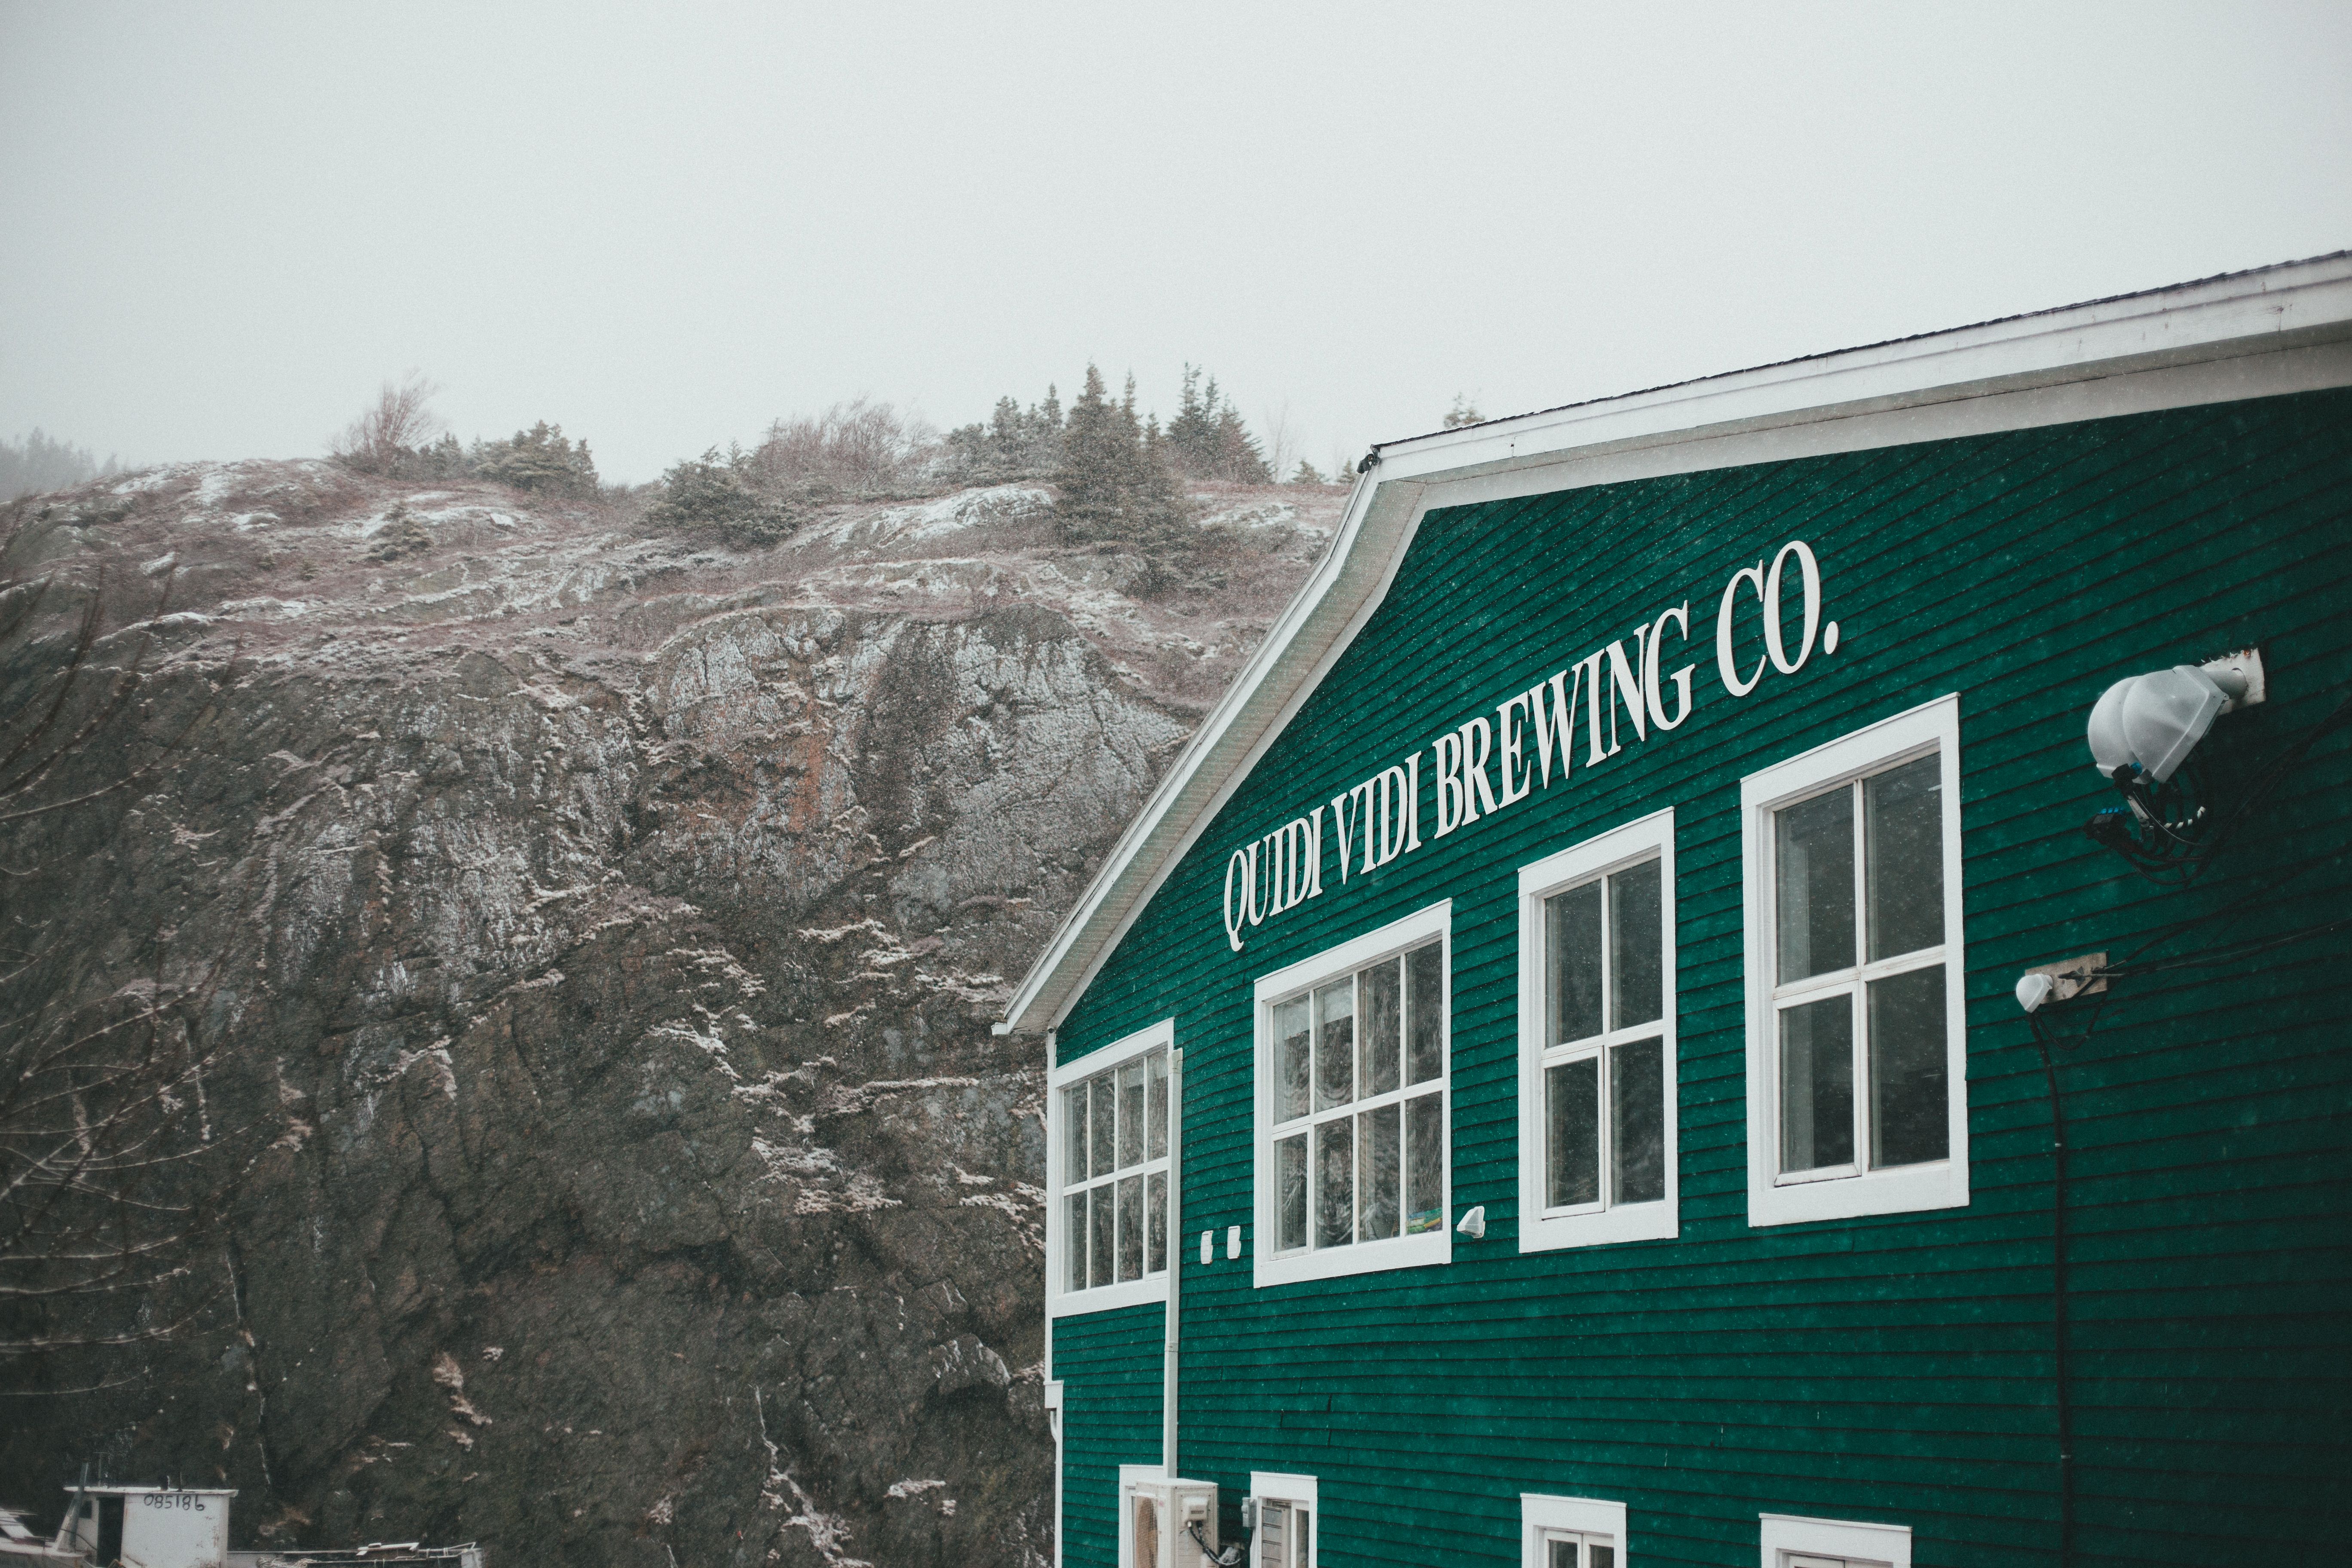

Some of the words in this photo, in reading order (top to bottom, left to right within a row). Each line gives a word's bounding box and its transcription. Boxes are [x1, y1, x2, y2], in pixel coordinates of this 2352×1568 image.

[1224, 805, 1324, 951] QUIDI
[1331, 751, 1421, 884] VIDI
[1433, 600, 1695, 839] BREWING
[1717, 541, 1838, 696] CO.
[144, 1494, 205, 1511] 085186
